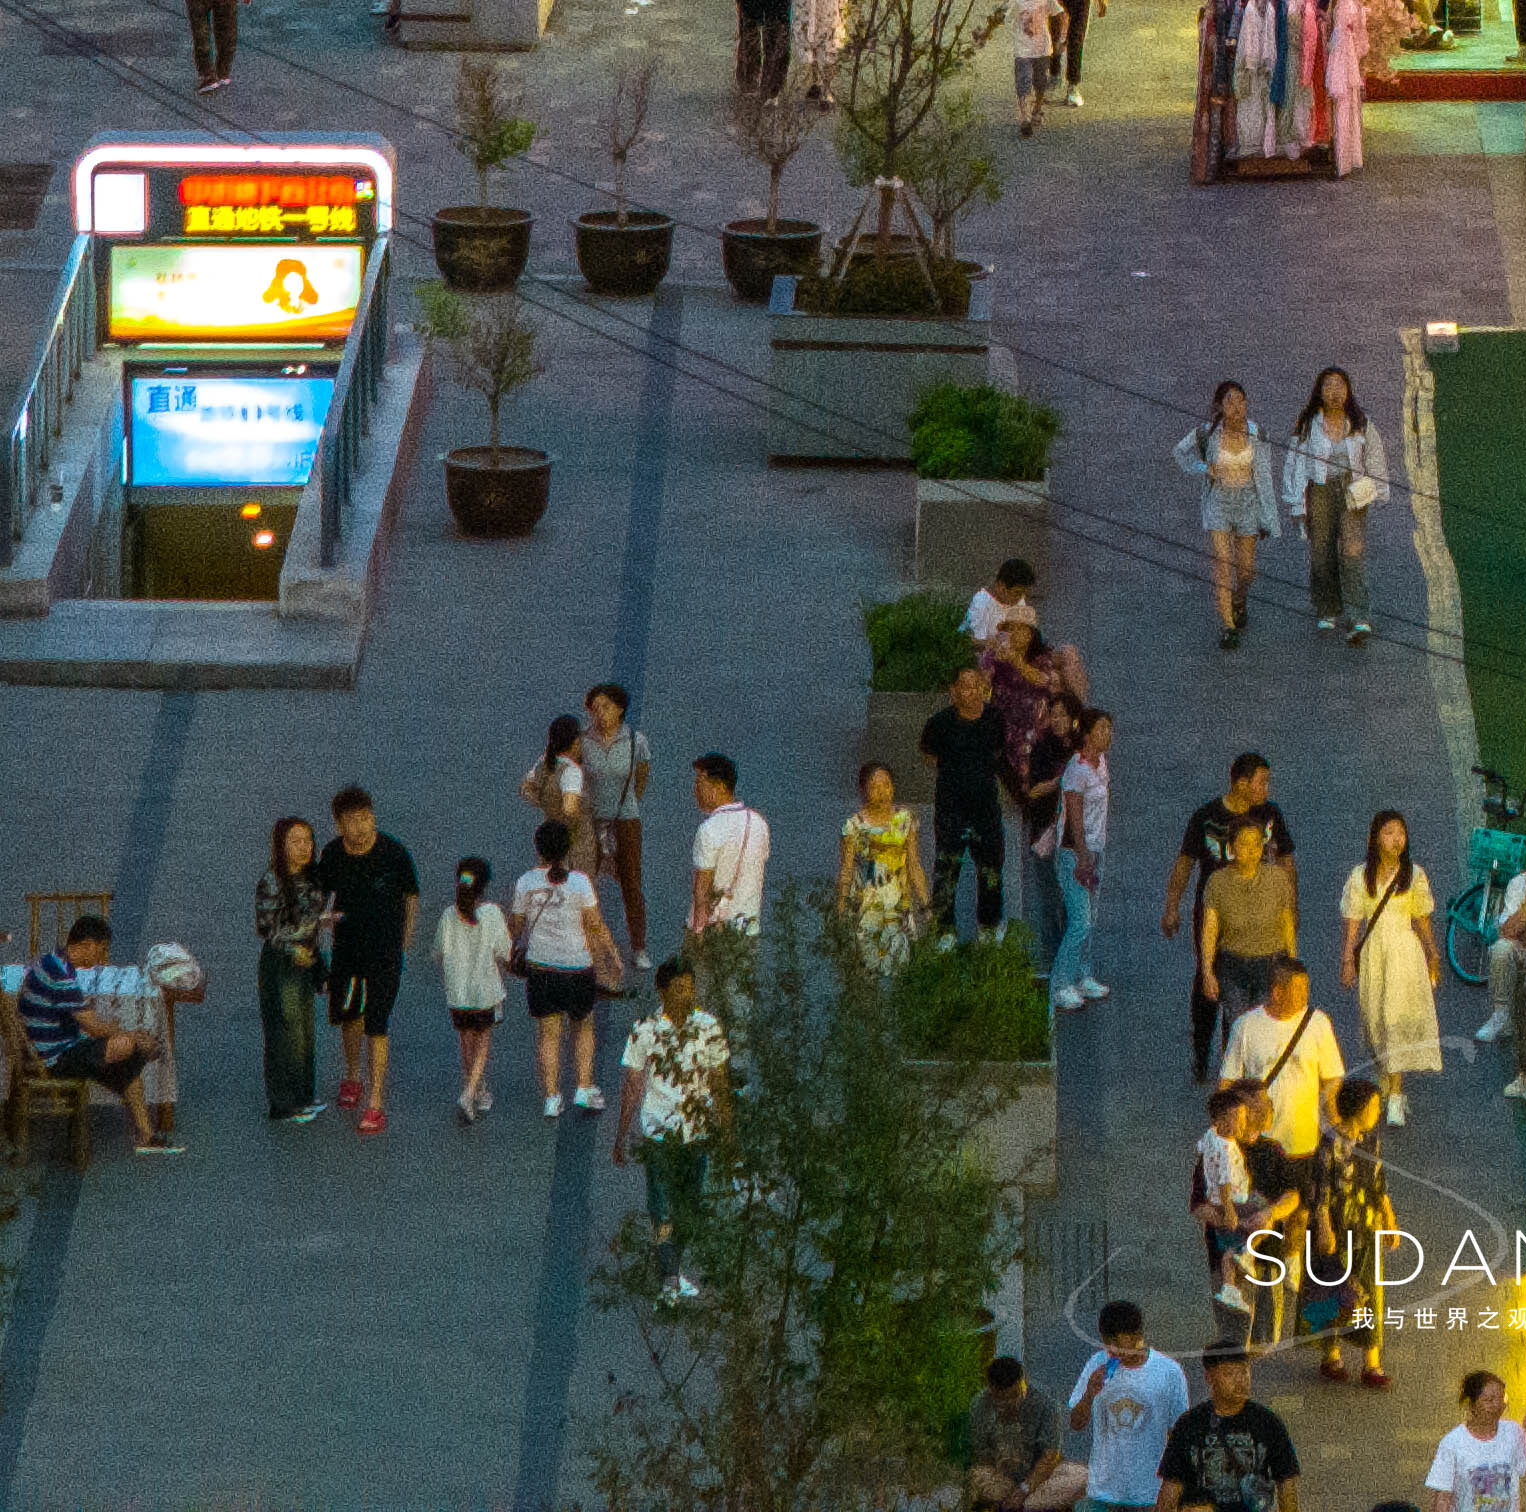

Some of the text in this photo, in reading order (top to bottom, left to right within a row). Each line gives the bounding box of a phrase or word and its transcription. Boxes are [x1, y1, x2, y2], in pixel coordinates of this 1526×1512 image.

[186, 205, 357, 232] 直通地铁一号线
[147, 385, 197, 414] 直通
